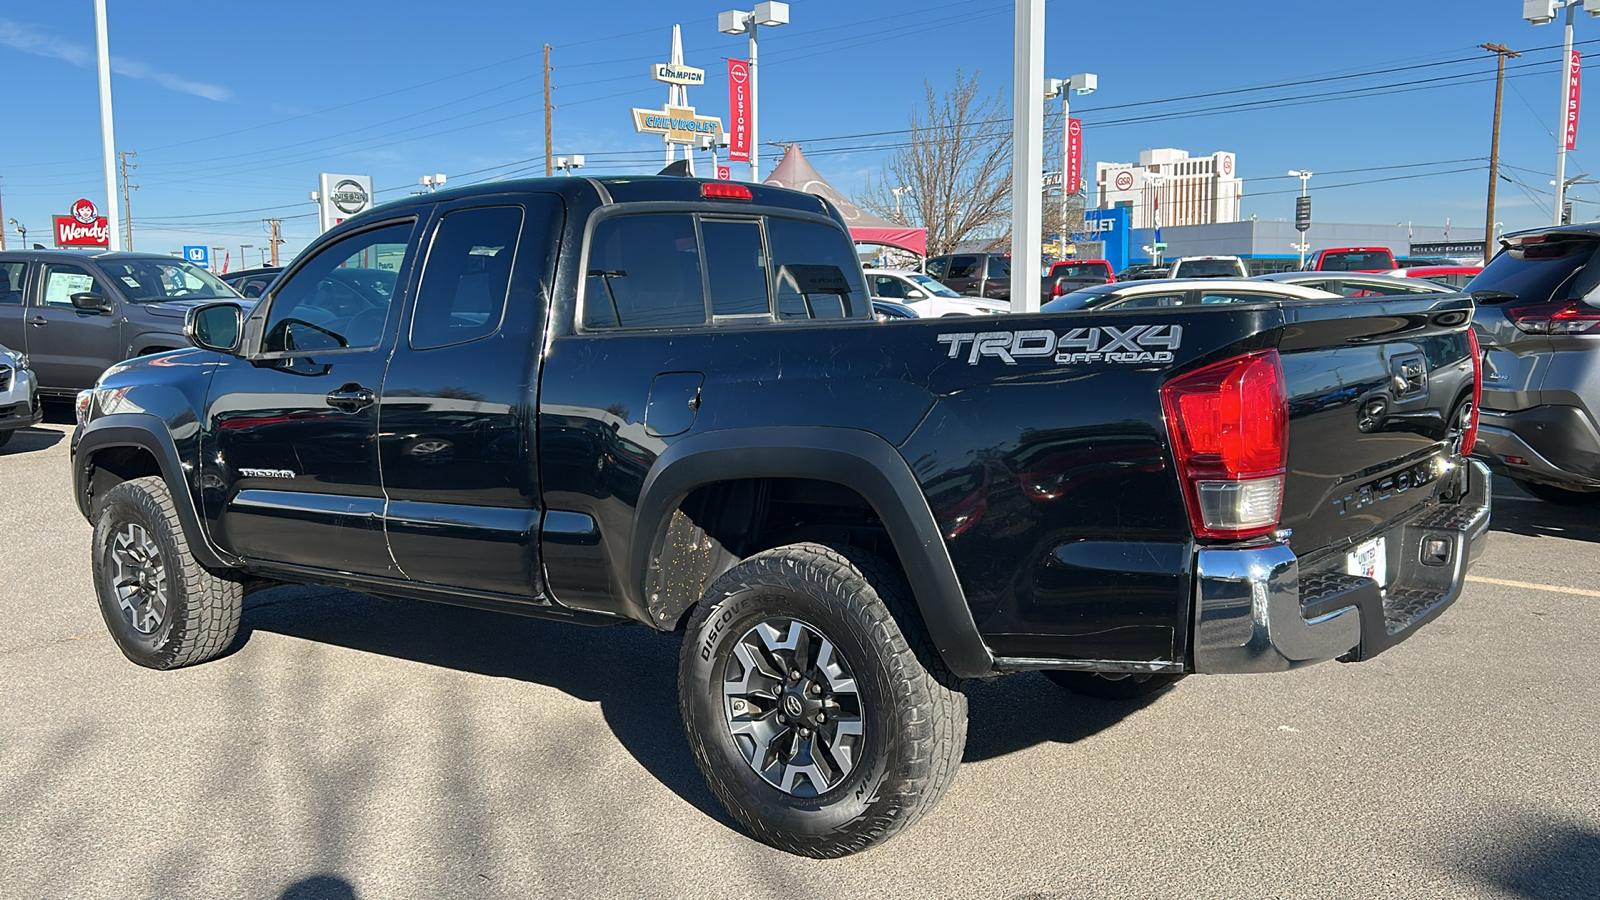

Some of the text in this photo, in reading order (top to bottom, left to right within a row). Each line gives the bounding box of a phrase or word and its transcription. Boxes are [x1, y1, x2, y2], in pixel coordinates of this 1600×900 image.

[737, 86, 745, 148] CUSTOMER
[1567, 77, 1578, 144] NISSAN
[646, 116, 718, 132] CHEVROLET
[1117, 177, 1132, 186] GSR
[335, 193, 365, 201] NISSAN
[1412, 245, 1482, 253] SILVERADO
[937, 329, 1058, 365] TRD
[1054, 351, 1175, 364] OFF ROAD
[238, 468, 296, 479] TACOMA
[700, 593, 788, 662] DISCOVERER
